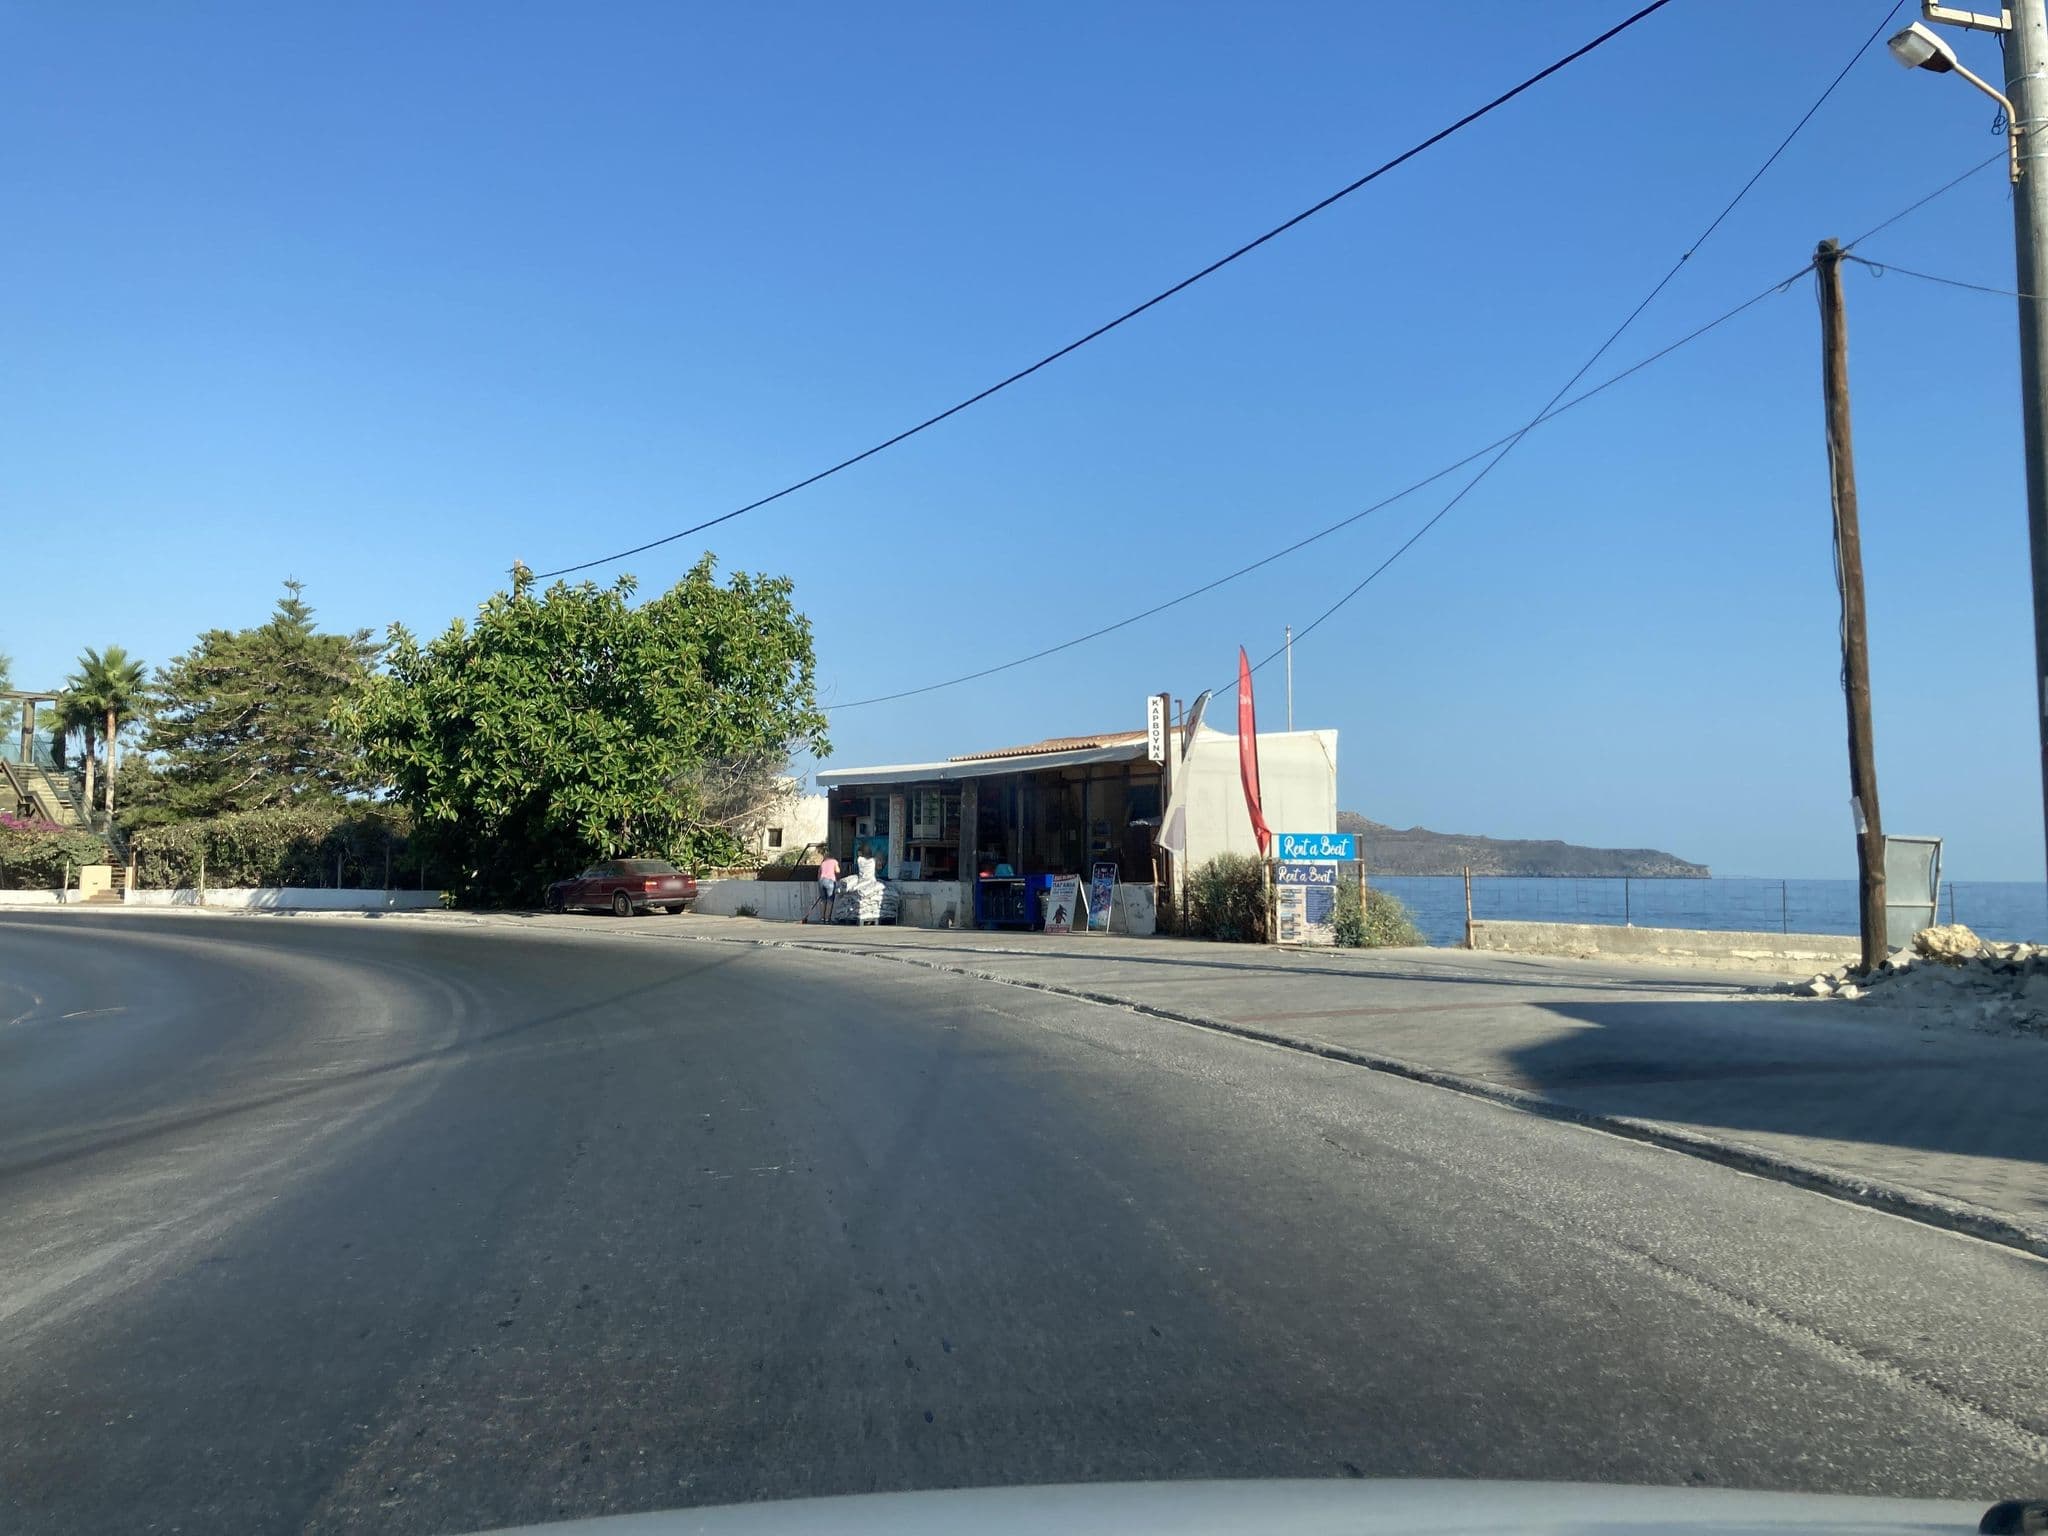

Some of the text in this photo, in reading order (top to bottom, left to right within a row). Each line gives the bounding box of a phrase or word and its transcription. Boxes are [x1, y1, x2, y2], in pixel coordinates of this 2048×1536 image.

[1152, 699, 1160, 759] ΚΑΡΒΟΥΝΑ
[1284, 836, 1350, 857] Rent a Boat
[1279, 866, 1334, 883] Rent a Boat
